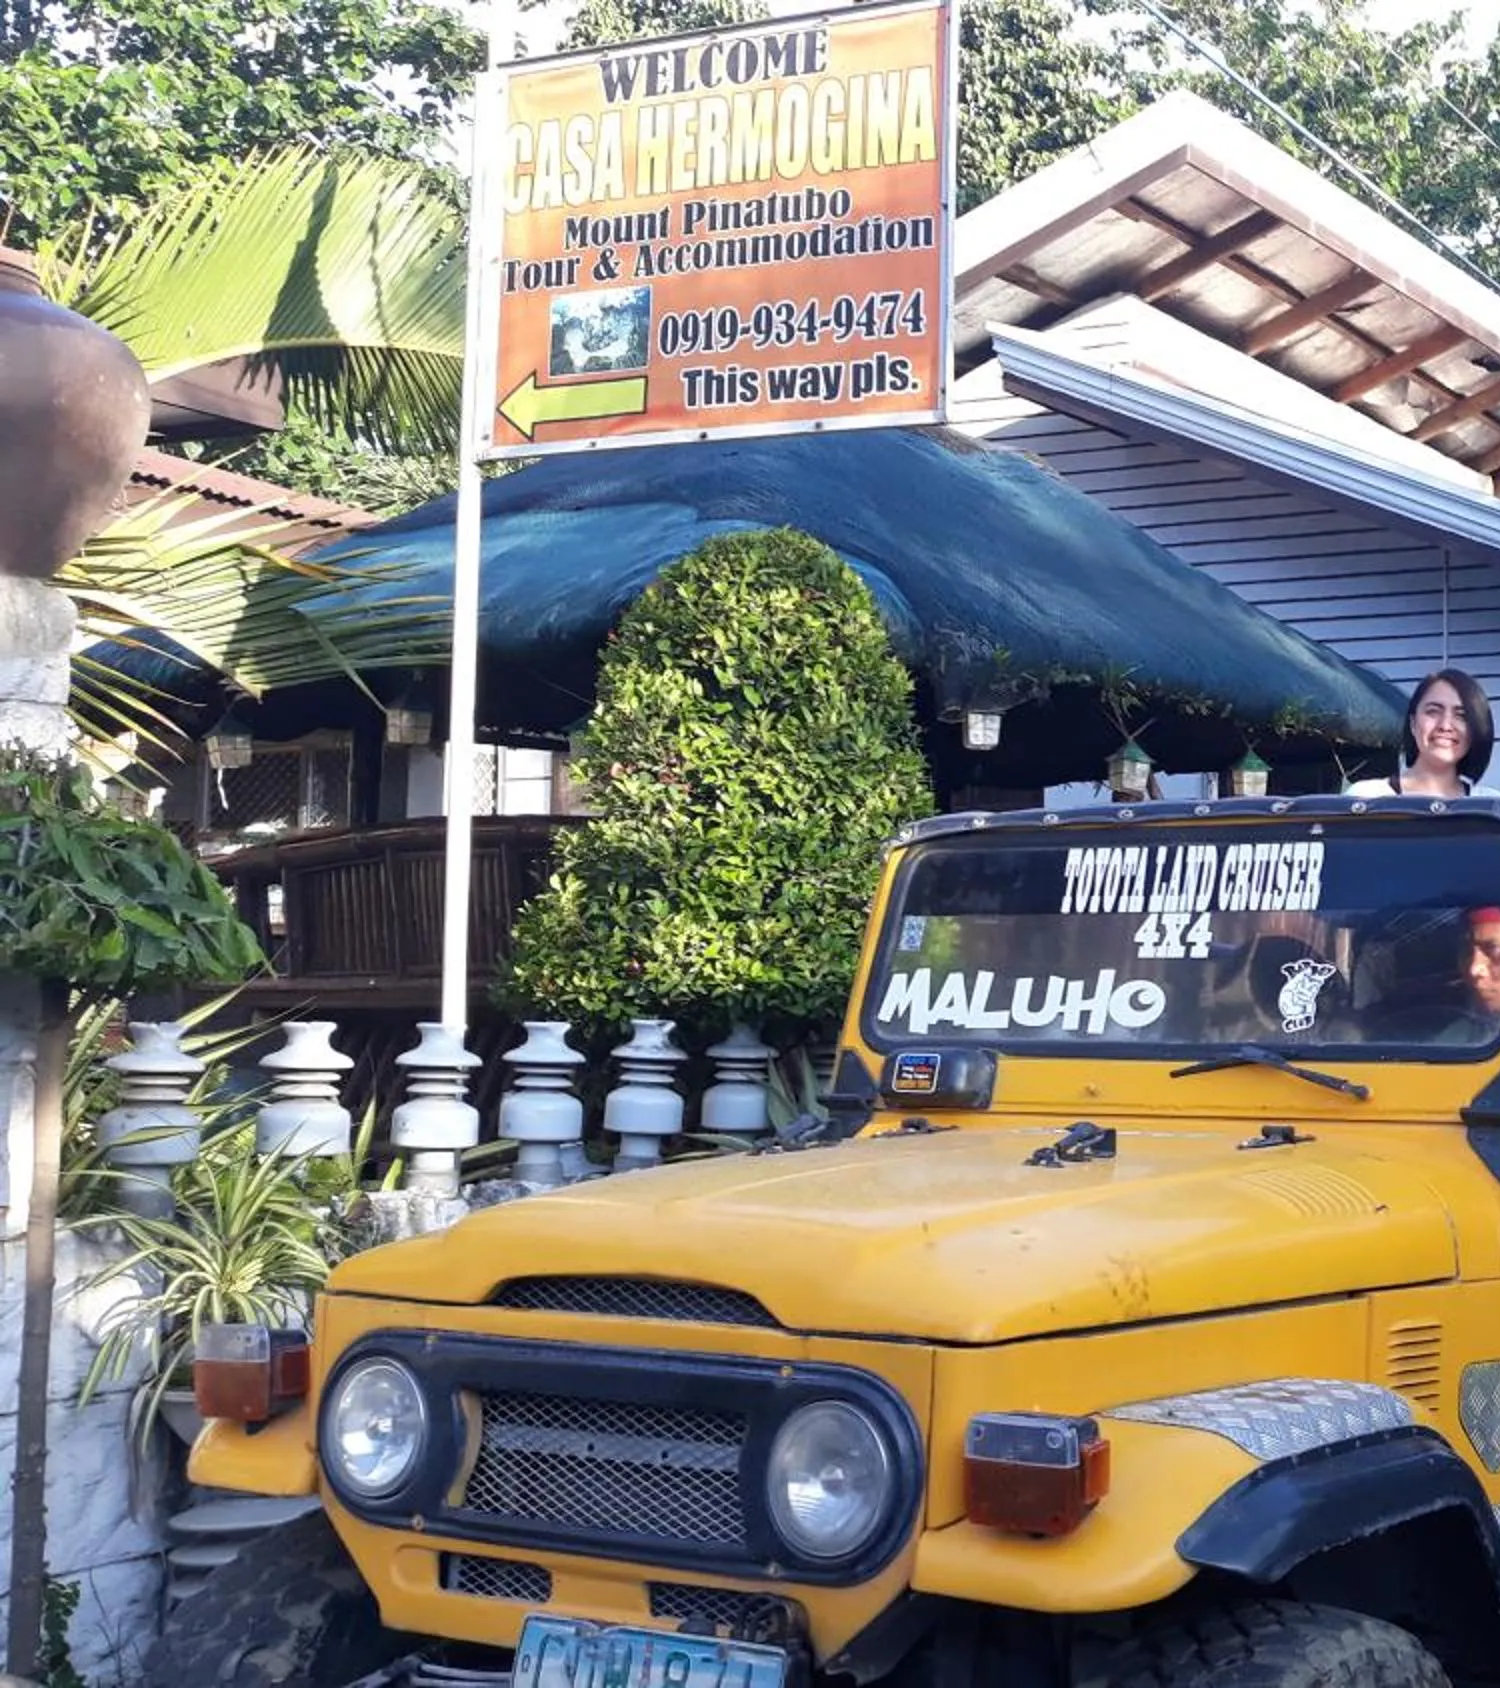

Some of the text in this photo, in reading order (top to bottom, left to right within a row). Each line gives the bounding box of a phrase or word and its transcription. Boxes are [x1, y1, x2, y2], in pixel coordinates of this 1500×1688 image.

[600, 29, 828, 104] WELCOME
[503, 65, 938, 215] CASA HERMOGINA
[563, 187, 852, 250] Mount Pinatubo
[502, 216, 934, 293] Tour & Accommodation
[659, 290, 925, 357] 0919-934-9474
[682, 354, 920, 407] This way pls.
[1061, 842, 1325, 914] TOYOTA LAND CRUISER
[877, 967, 1166, 1035] MALUHO
